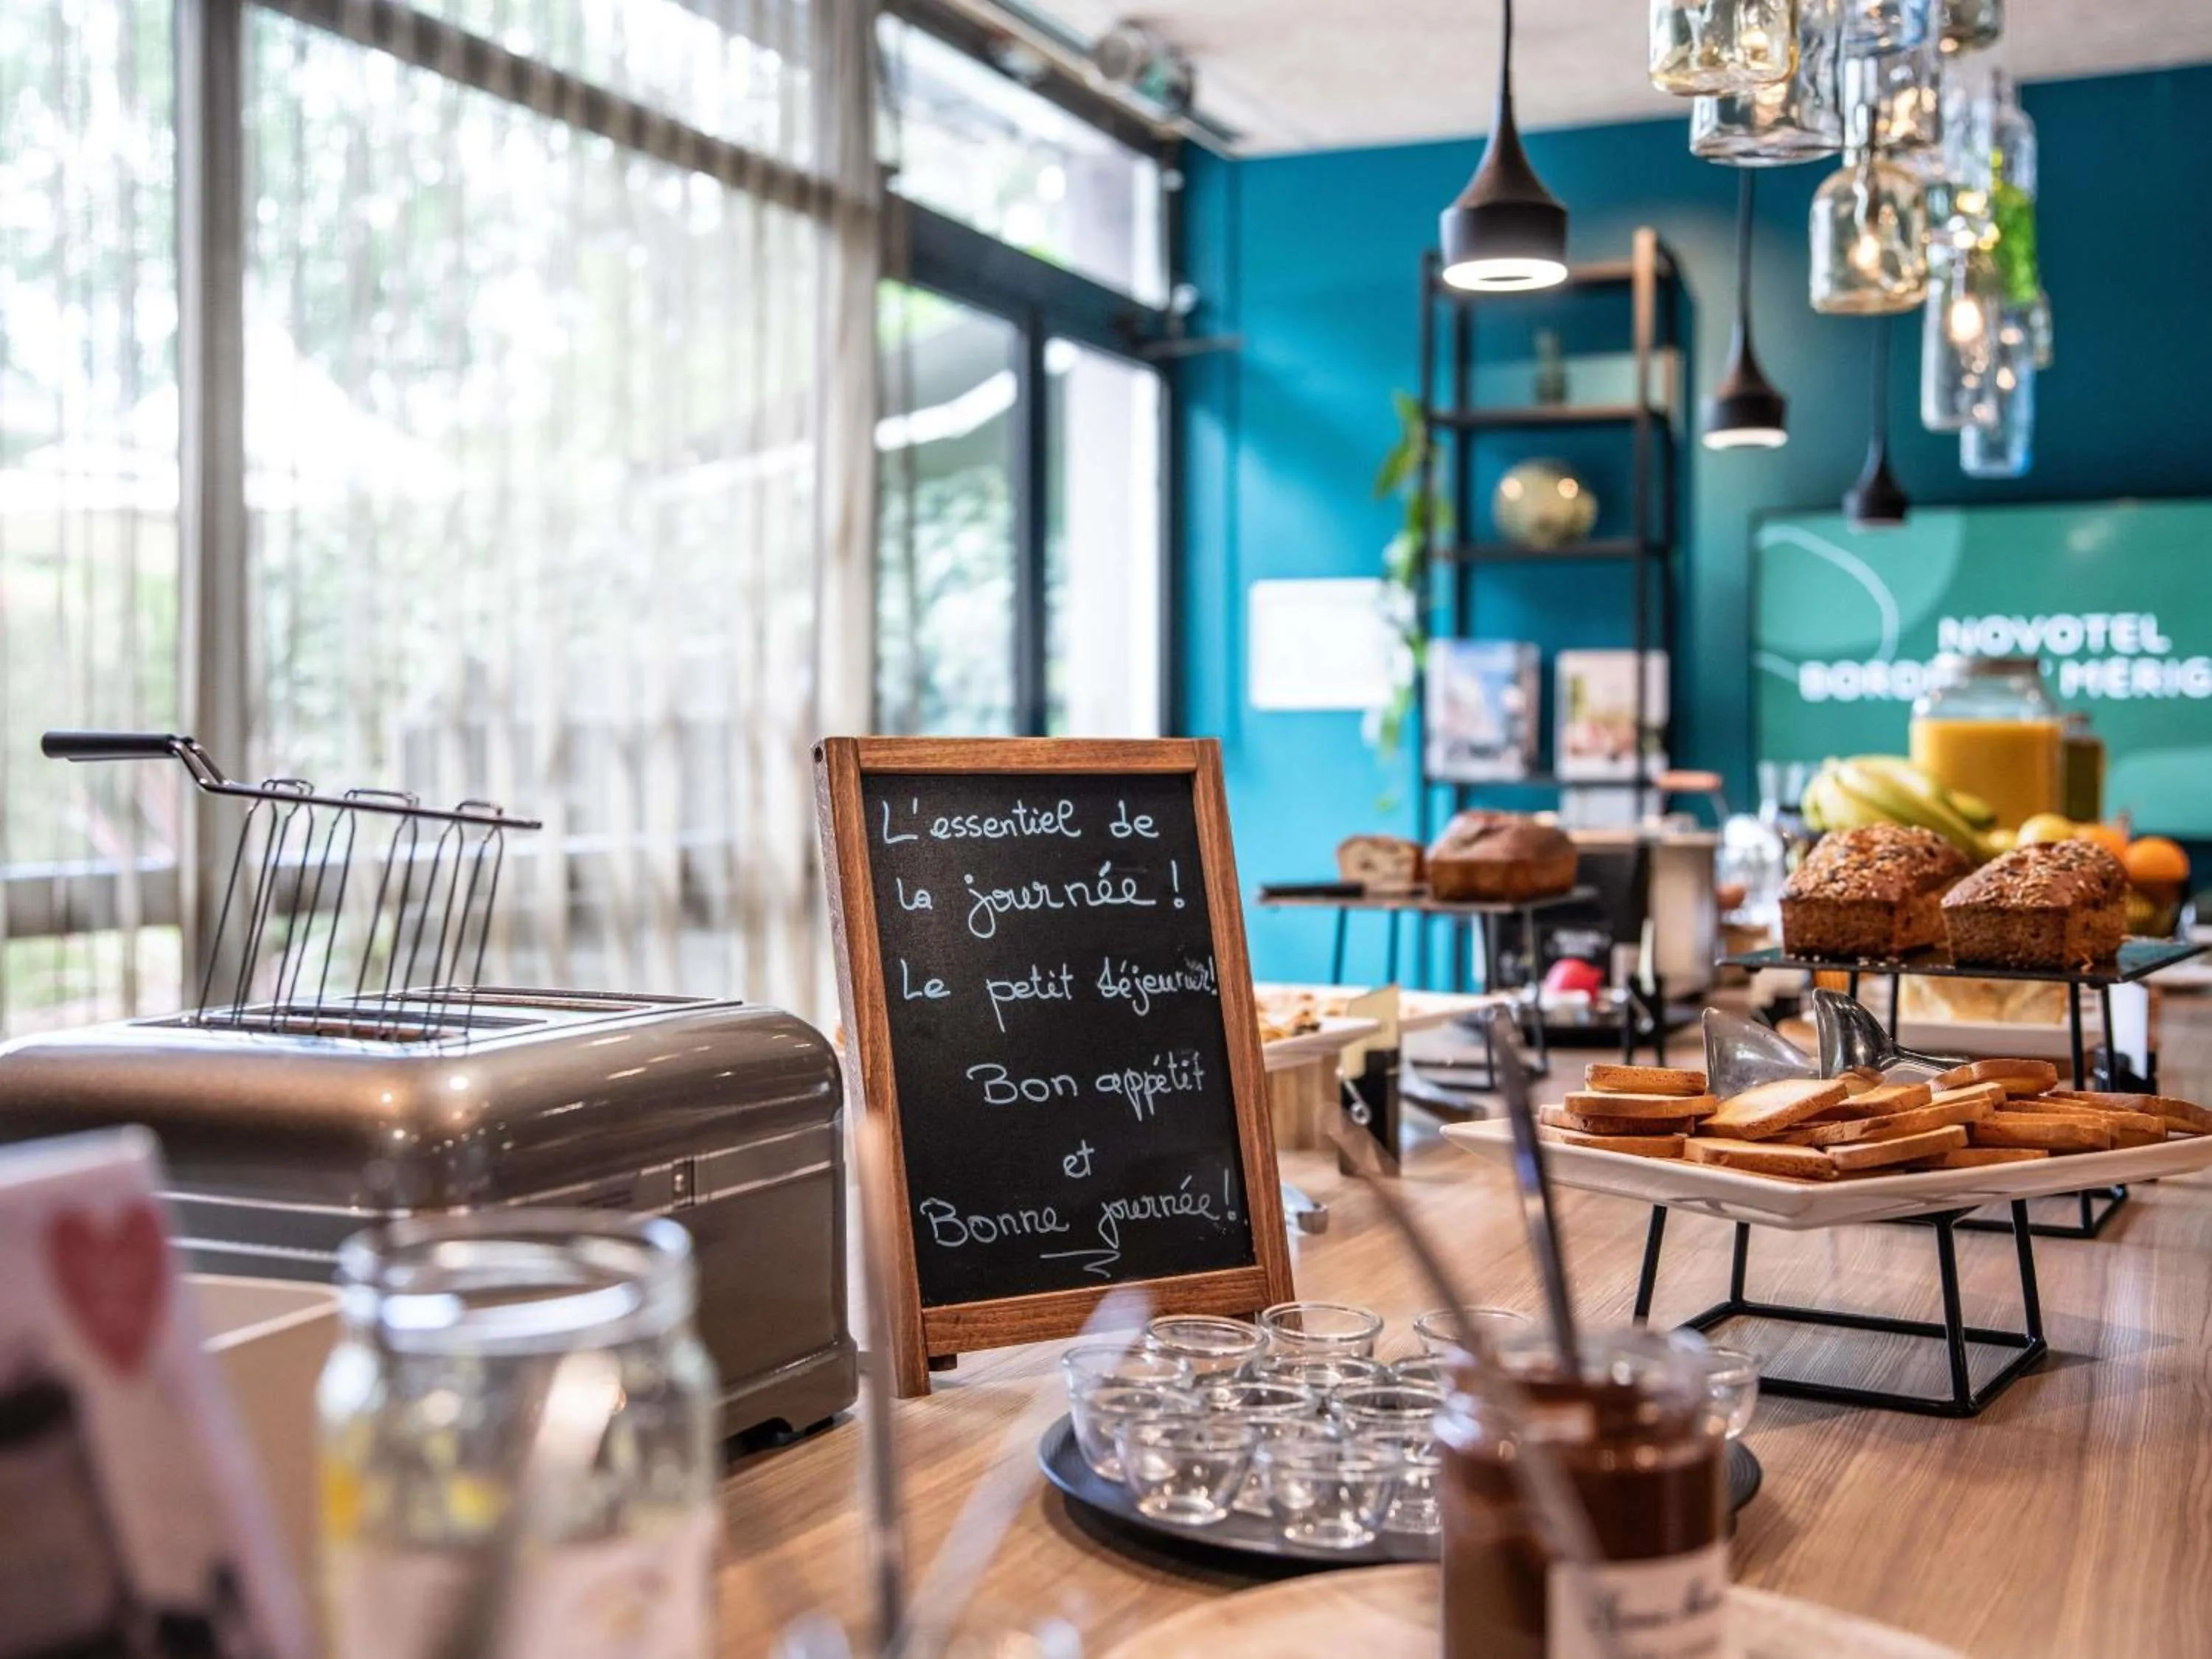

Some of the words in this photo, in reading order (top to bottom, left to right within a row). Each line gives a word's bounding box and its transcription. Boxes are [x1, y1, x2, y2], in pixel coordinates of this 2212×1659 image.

[1938, 611, 2173, 657] NOVOTEL
[882, 797, 1082, 844] L'essentiel
[1109, 799, 1160, 839] de
[900, 958, 952, 1001] Le
[985, 962, 1074, 1033] petit
[966, 1062, 1079, 1105] Bon
[1095, 1050, 1206, 1122] appétit
[1062, 1138, 1096, 1179] et
[919, 1197, 1071, 1248] Bonne
